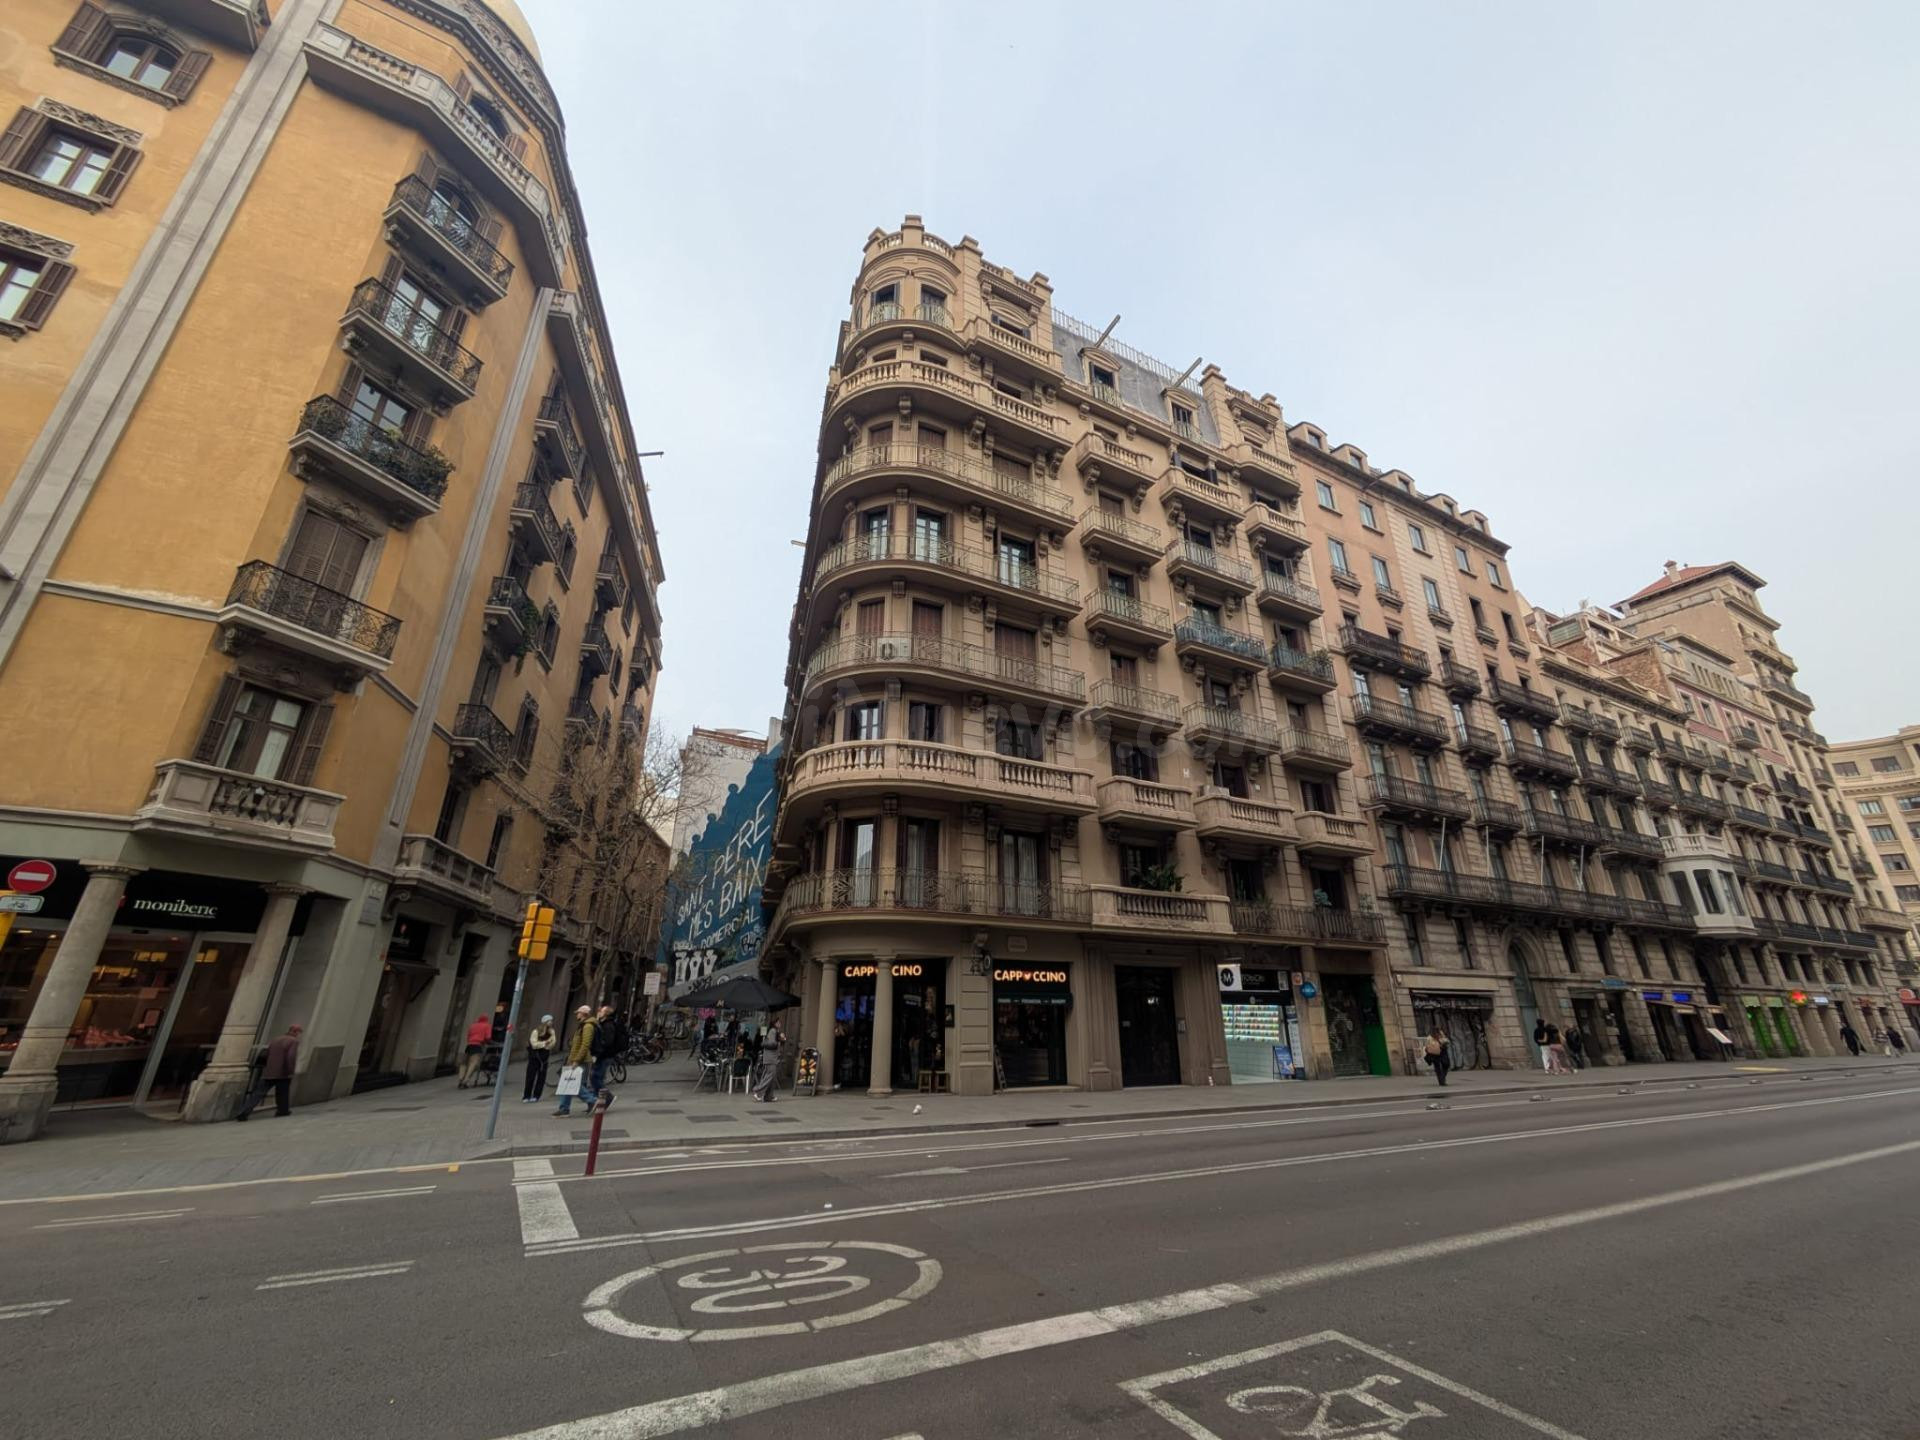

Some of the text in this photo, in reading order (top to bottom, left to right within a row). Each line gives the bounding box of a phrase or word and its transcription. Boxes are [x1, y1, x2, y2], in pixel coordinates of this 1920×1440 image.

[677, 874, 707, 926] SANT
[711, 788, 773, 890] PERE
[719, 844, 765, 919] BAIX
[677, 1255, 871, 1315] 30
